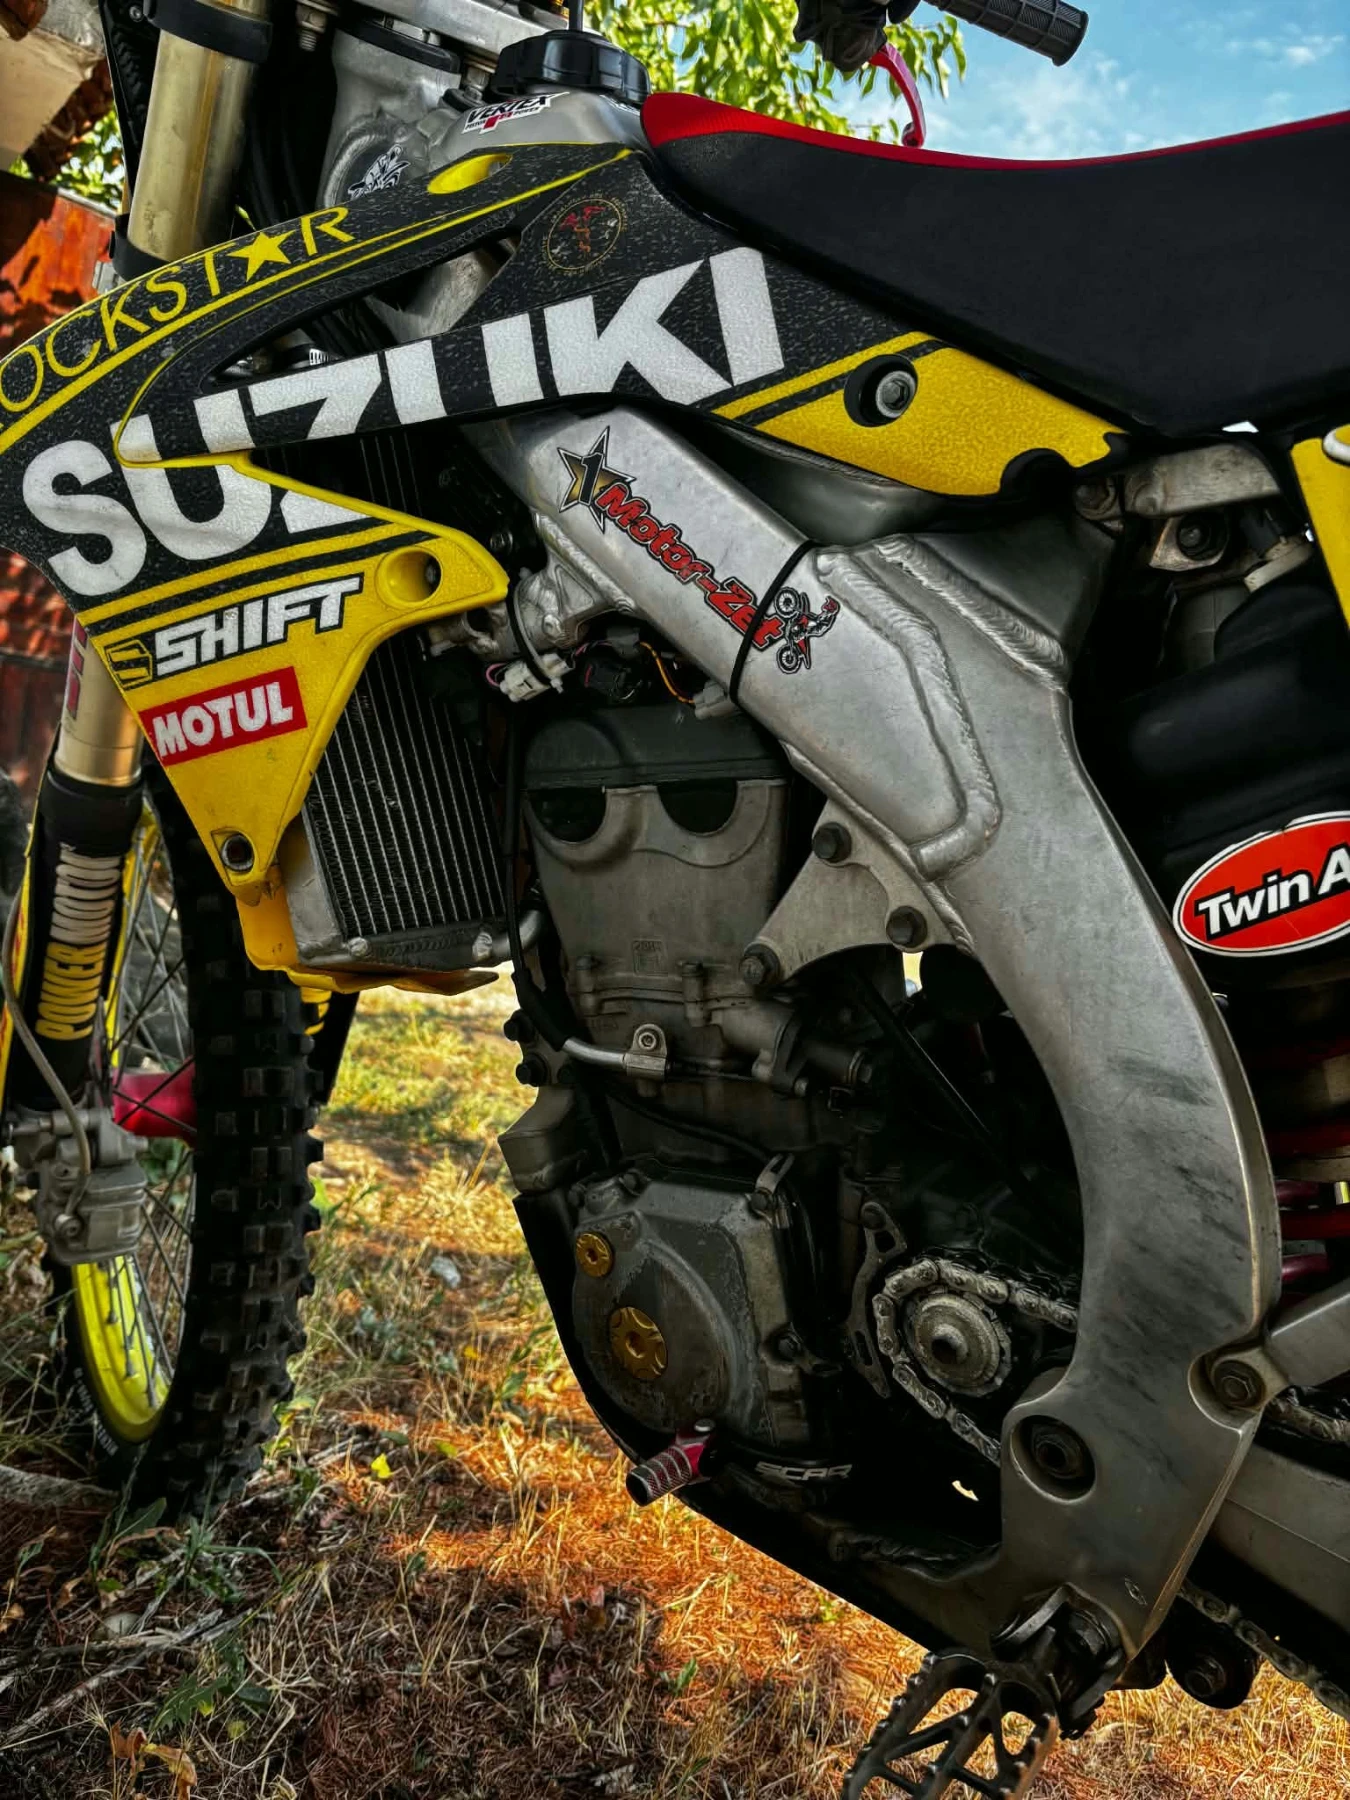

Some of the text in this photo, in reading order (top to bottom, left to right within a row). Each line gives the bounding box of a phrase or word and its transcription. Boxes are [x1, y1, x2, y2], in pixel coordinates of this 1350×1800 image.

[467, 95, 548, 124] VERTEX
[22, 246, 784, 597] SUZUKI
[579, 451, 604, 506] 1
[595, 481, 786, 649] Motor-Zet
[155, 576, 361, 677] SHIFT
[152, 681, 294, 759] MOTUL
[1198, 874, 1310, 935] Twin
